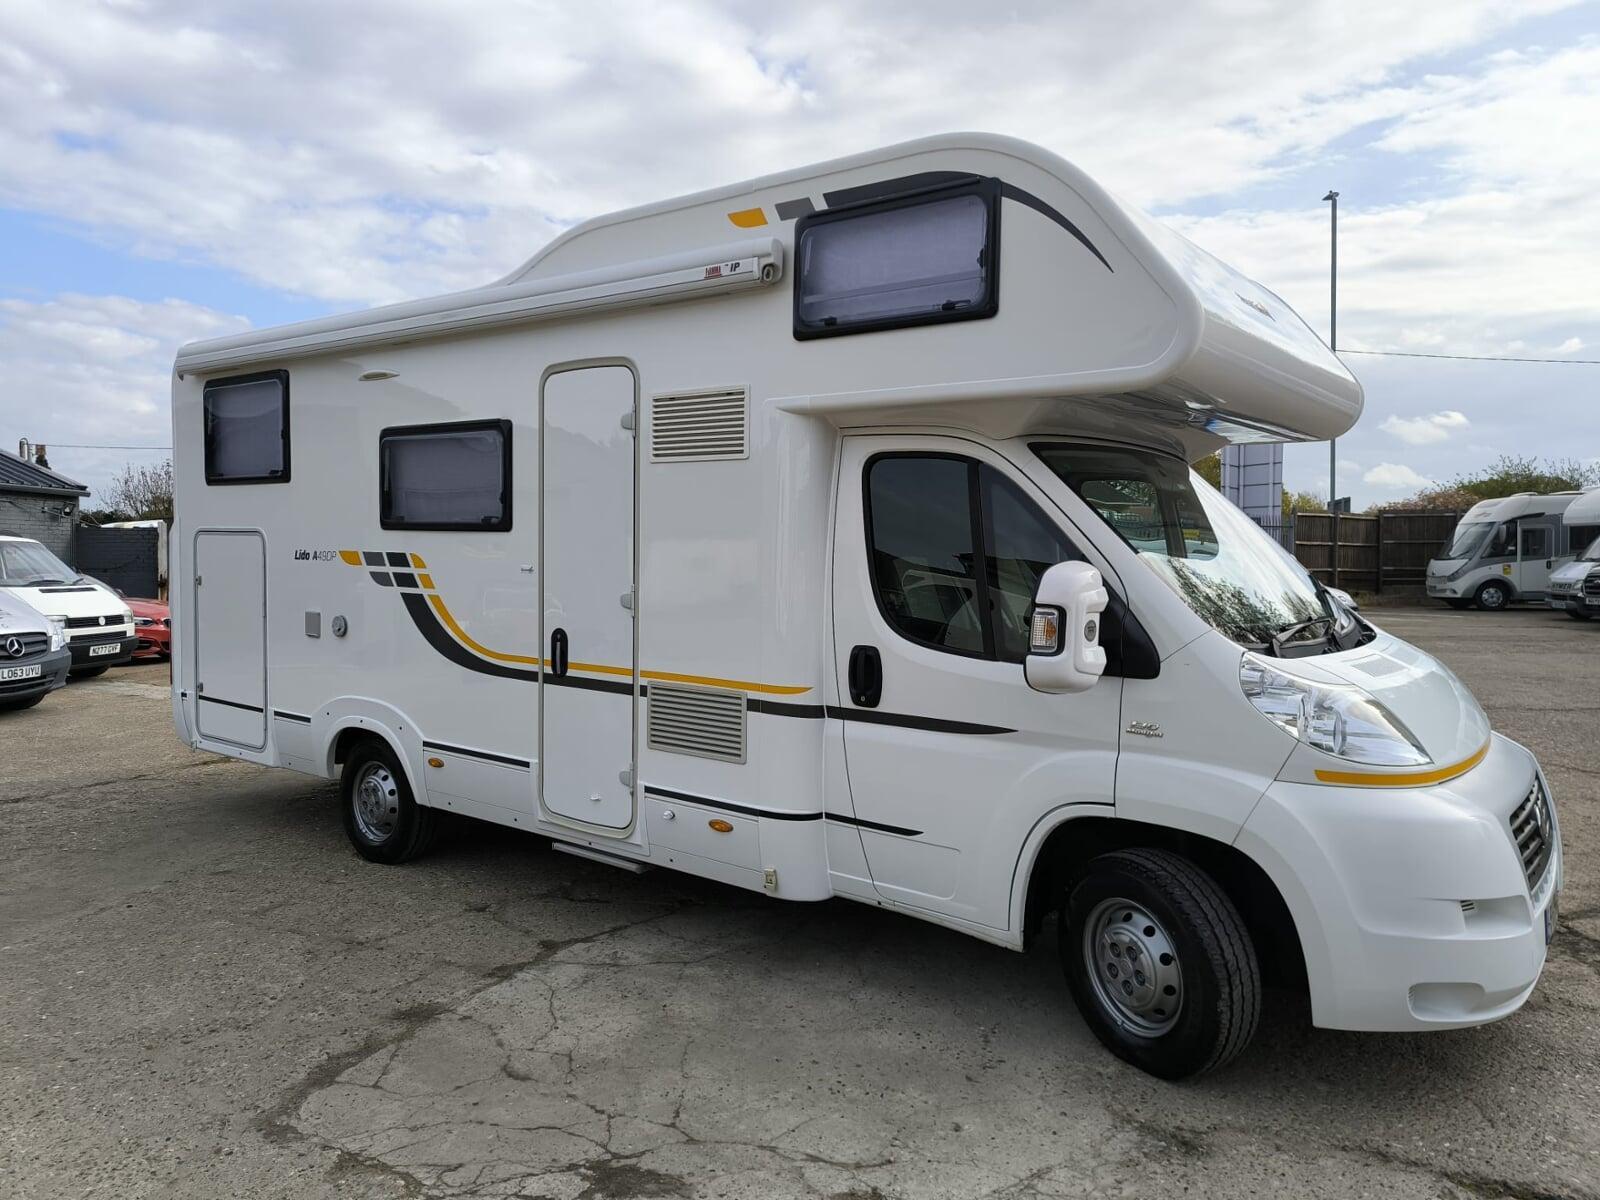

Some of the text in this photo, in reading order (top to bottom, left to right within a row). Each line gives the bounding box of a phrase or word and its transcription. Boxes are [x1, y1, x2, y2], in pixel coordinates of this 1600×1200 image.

[294, 549, 310, 561] Lido
[1, 666, 40, 680] LO63 UYU
